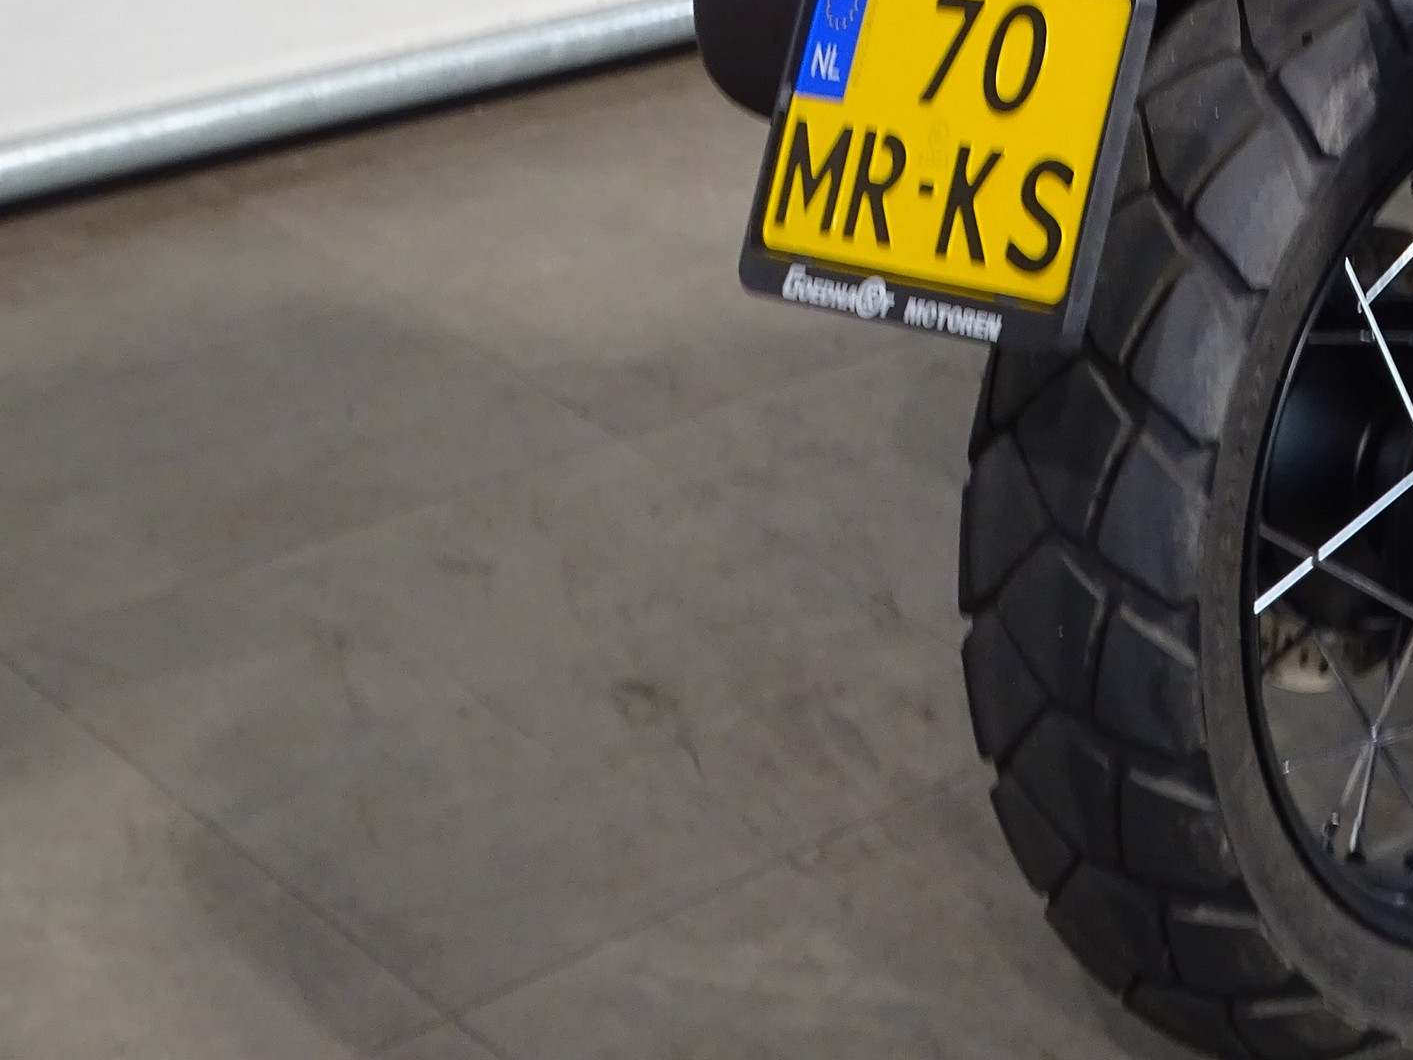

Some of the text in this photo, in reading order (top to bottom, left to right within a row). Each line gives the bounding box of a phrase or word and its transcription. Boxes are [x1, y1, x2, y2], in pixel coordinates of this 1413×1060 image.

[810, 41, 841, 83] NL
[774, 120, 1075, 273] MR-KS
[903, 295, 1003, 343] MOTOREN
